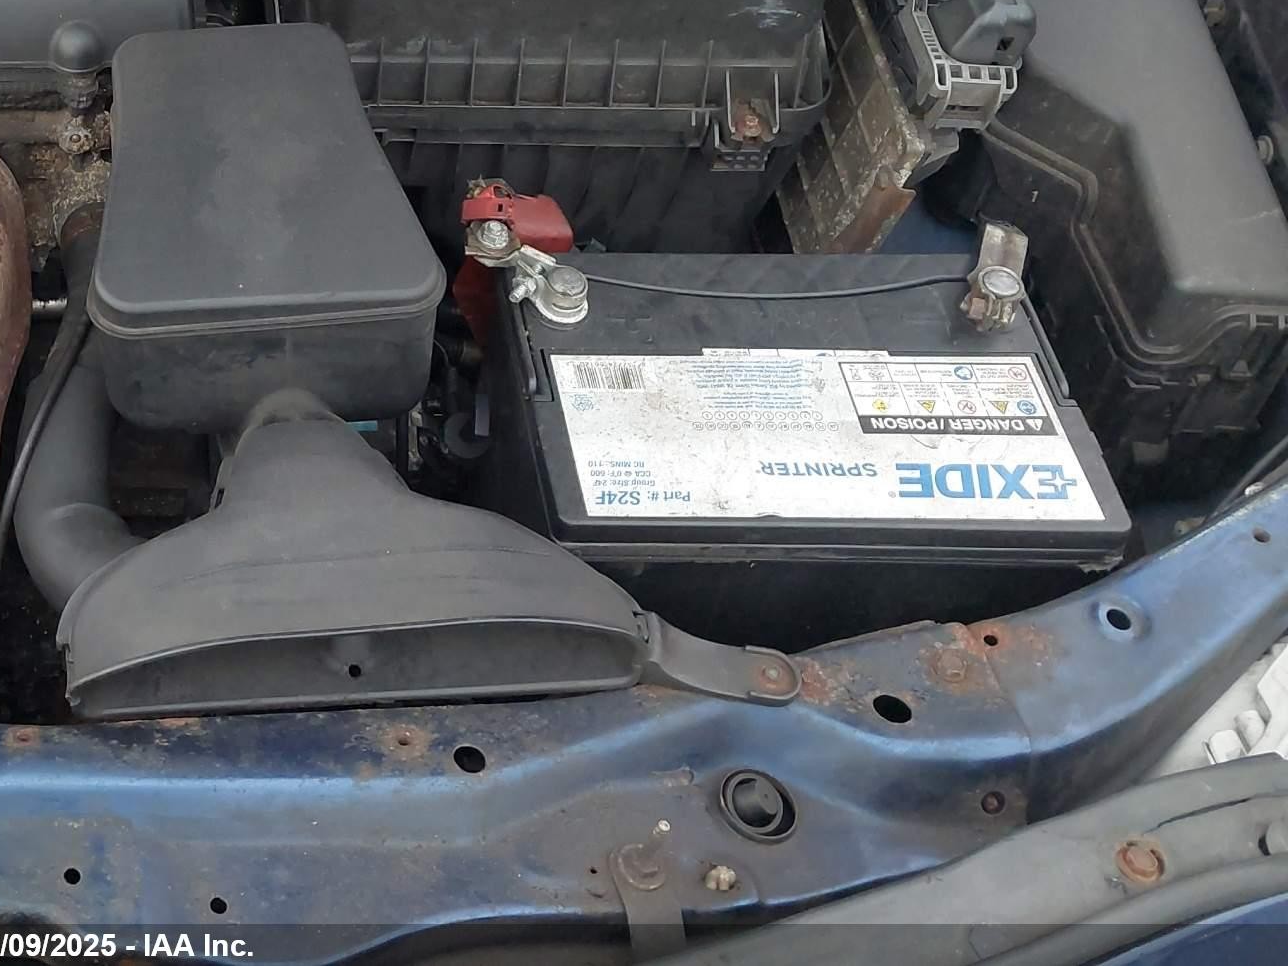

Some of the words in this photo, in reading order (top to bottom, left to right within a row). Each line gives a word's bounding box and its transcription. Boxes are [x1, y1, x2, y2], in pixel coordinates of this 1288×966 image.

[870, 417, 935, 430] POISON
[948, 418, 1025, 431] DANGER
[759, 461, 876, 478] SPRINTER
[895, 462, 1077, 500] EXIDE
[594, 491, 641, 505] S24F
[663, 491, 691, 502] Part
